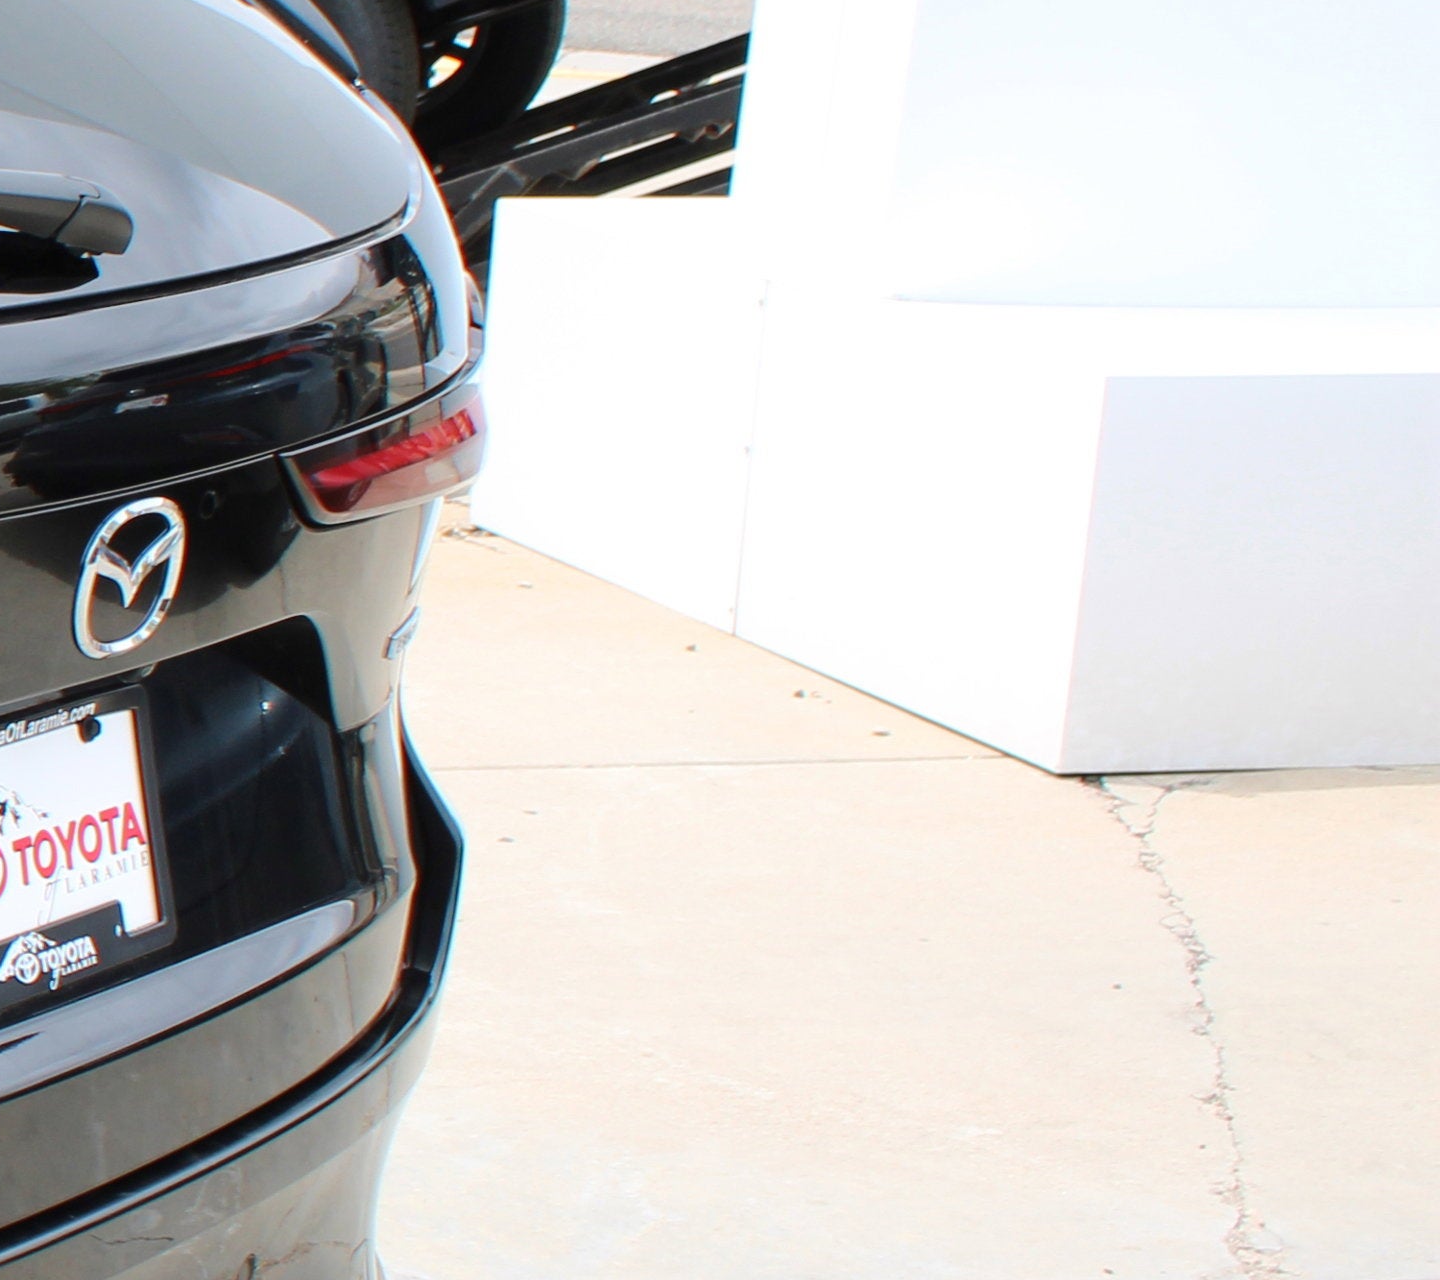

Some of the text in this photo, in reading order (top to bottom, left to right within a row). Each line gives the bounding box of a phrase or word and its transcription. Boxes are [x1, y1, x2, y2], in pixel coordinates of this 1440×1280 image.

[12, 801, 147, 886] TOYOTA
[65, 850, 150, 894] LARAMIE
[39, 935, 98, 972] TOYOTA
